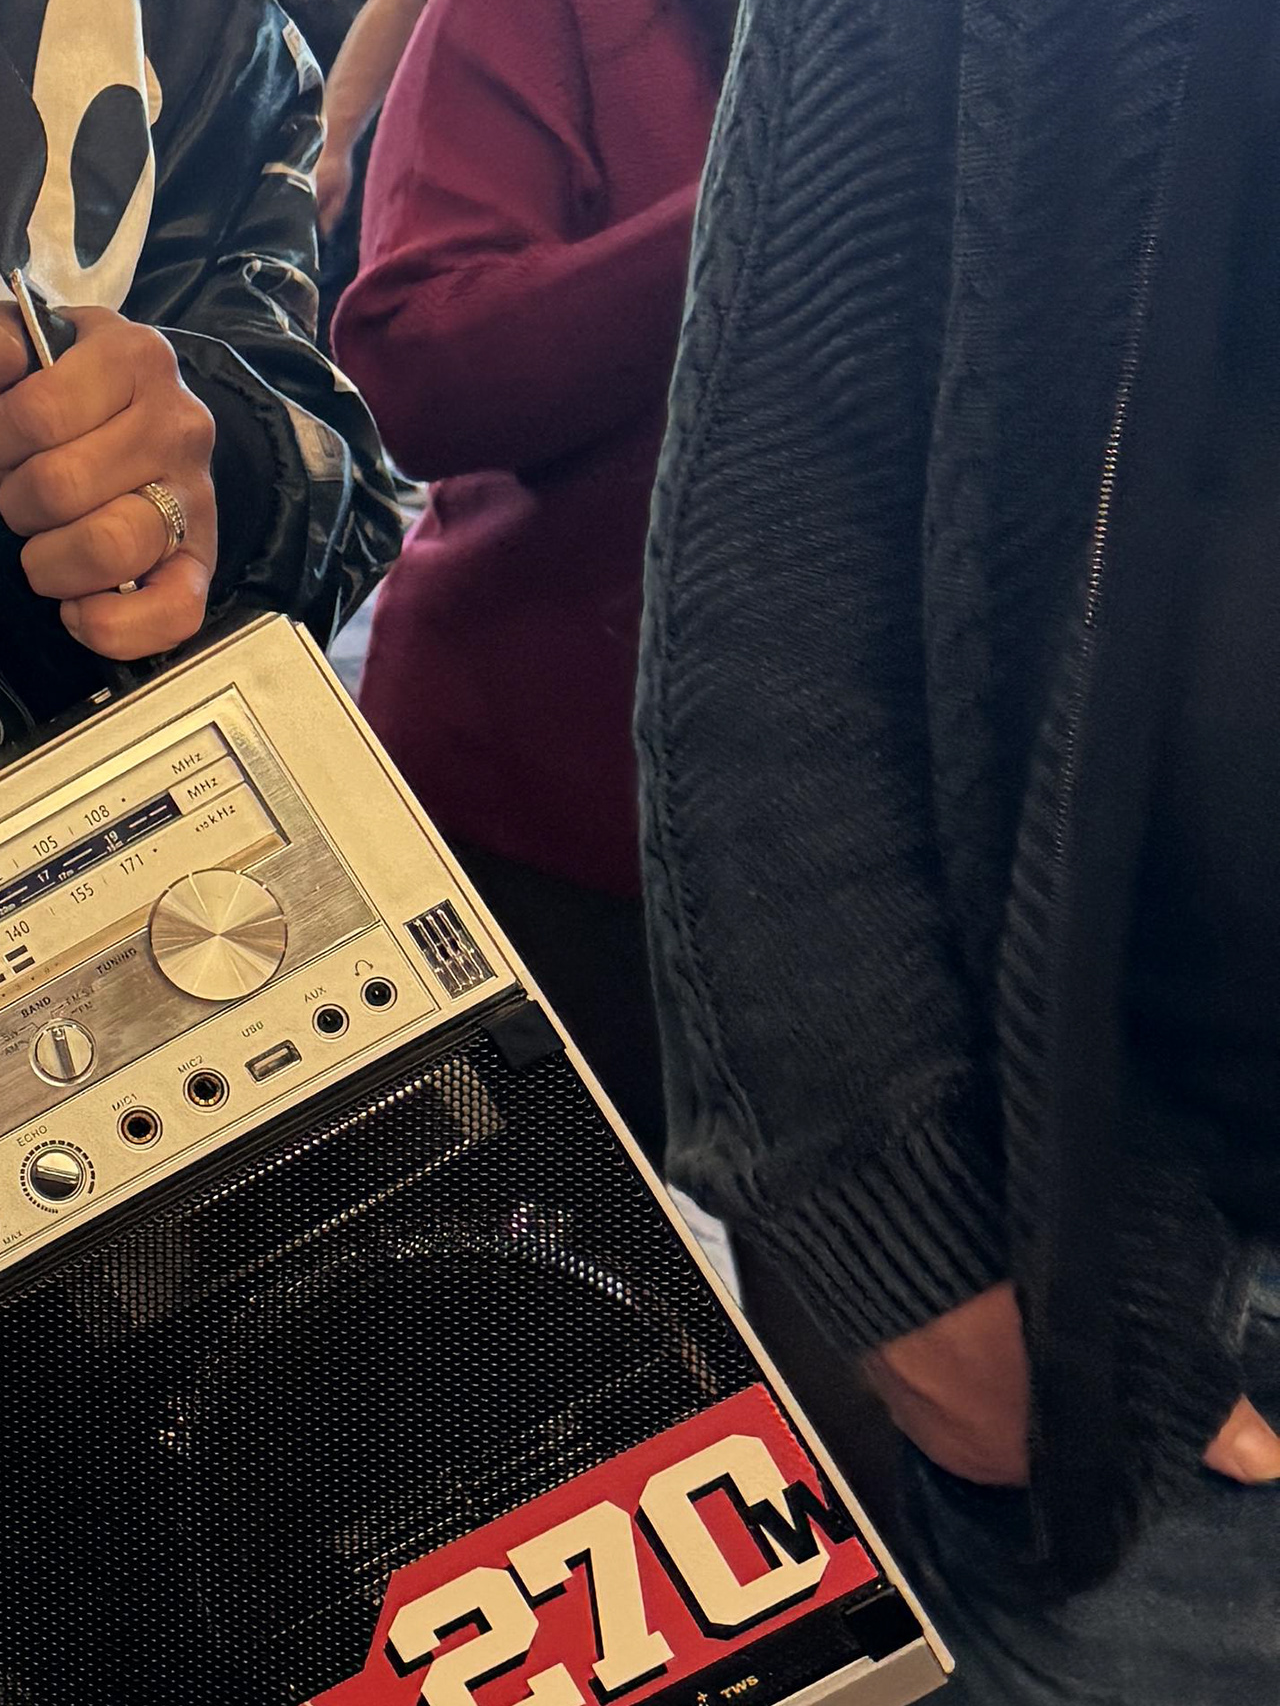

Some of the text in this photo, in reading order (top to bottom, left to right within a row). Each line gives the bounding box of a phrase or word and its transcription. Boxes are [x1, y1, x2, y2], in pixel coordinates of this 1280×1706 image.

[33, 836, 59, 858] 105
[84, 804, 111, 827] 108
[172, 750, 204, 776] MHz
[37, 869, 52, 883] 17
[104, 830, 119, 844] 19
[187, 776, 219, 800] MHz
[5, 920, 31, 943] 140
[69, 882, 95, 904] 155
[119, 852, 145, 875] 171
[96, 946, 138, 975] TUNING
[21, 995, 52, 1018] BAND
[302, 984, 327, 1003] AUX
[17, 1123, 49, 1147] ECHO
[719, 1671, 761, 1702] TWS
